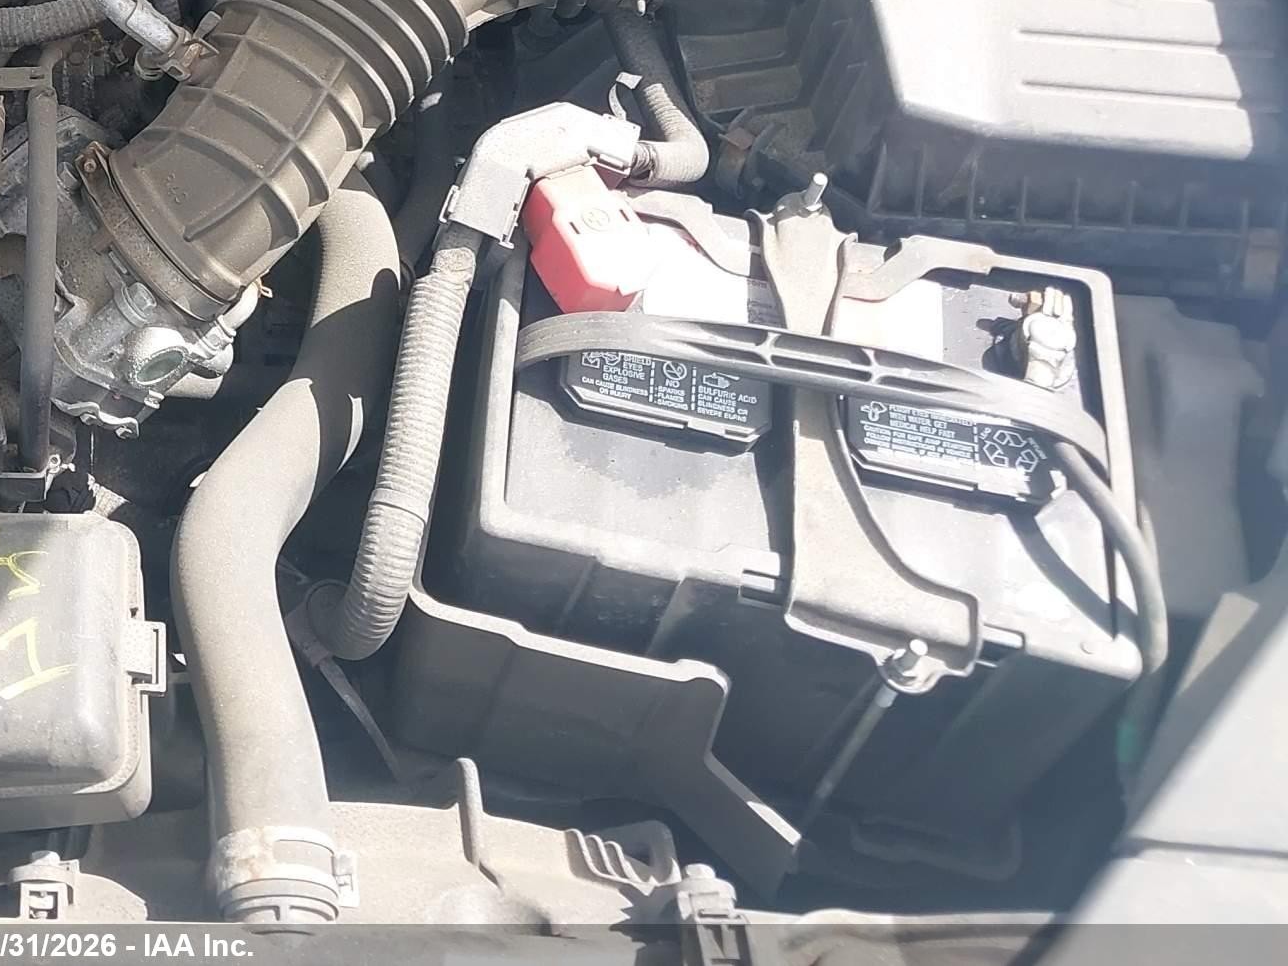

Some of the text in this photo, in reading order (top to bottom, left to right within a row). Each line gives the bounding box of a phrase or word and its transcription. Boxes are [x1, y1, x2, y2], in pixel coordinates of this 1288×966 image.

[603, 364, 646, 380] EXPLOSIVE
[622, 361, 643, 372] EYES
[602, 373, 628, 385] GASES
[665, 379, 680, 388] NO
[581, 376, 649, 397] CAN CAUSE BLINDNESS
[599, 387, 609, 395] OR
[697, 394, 737, 407] CAN CAUSE
[698, 385, 758, 404] SULFURIC ACID
[697, 401, 749, 416] BLINDNESS OR
[697, 407, 747, 423] SEVERE BURNS
[889, 419, 956, 439] MEDICAL HELP FAST
[933, 420, 948, 430] GET
